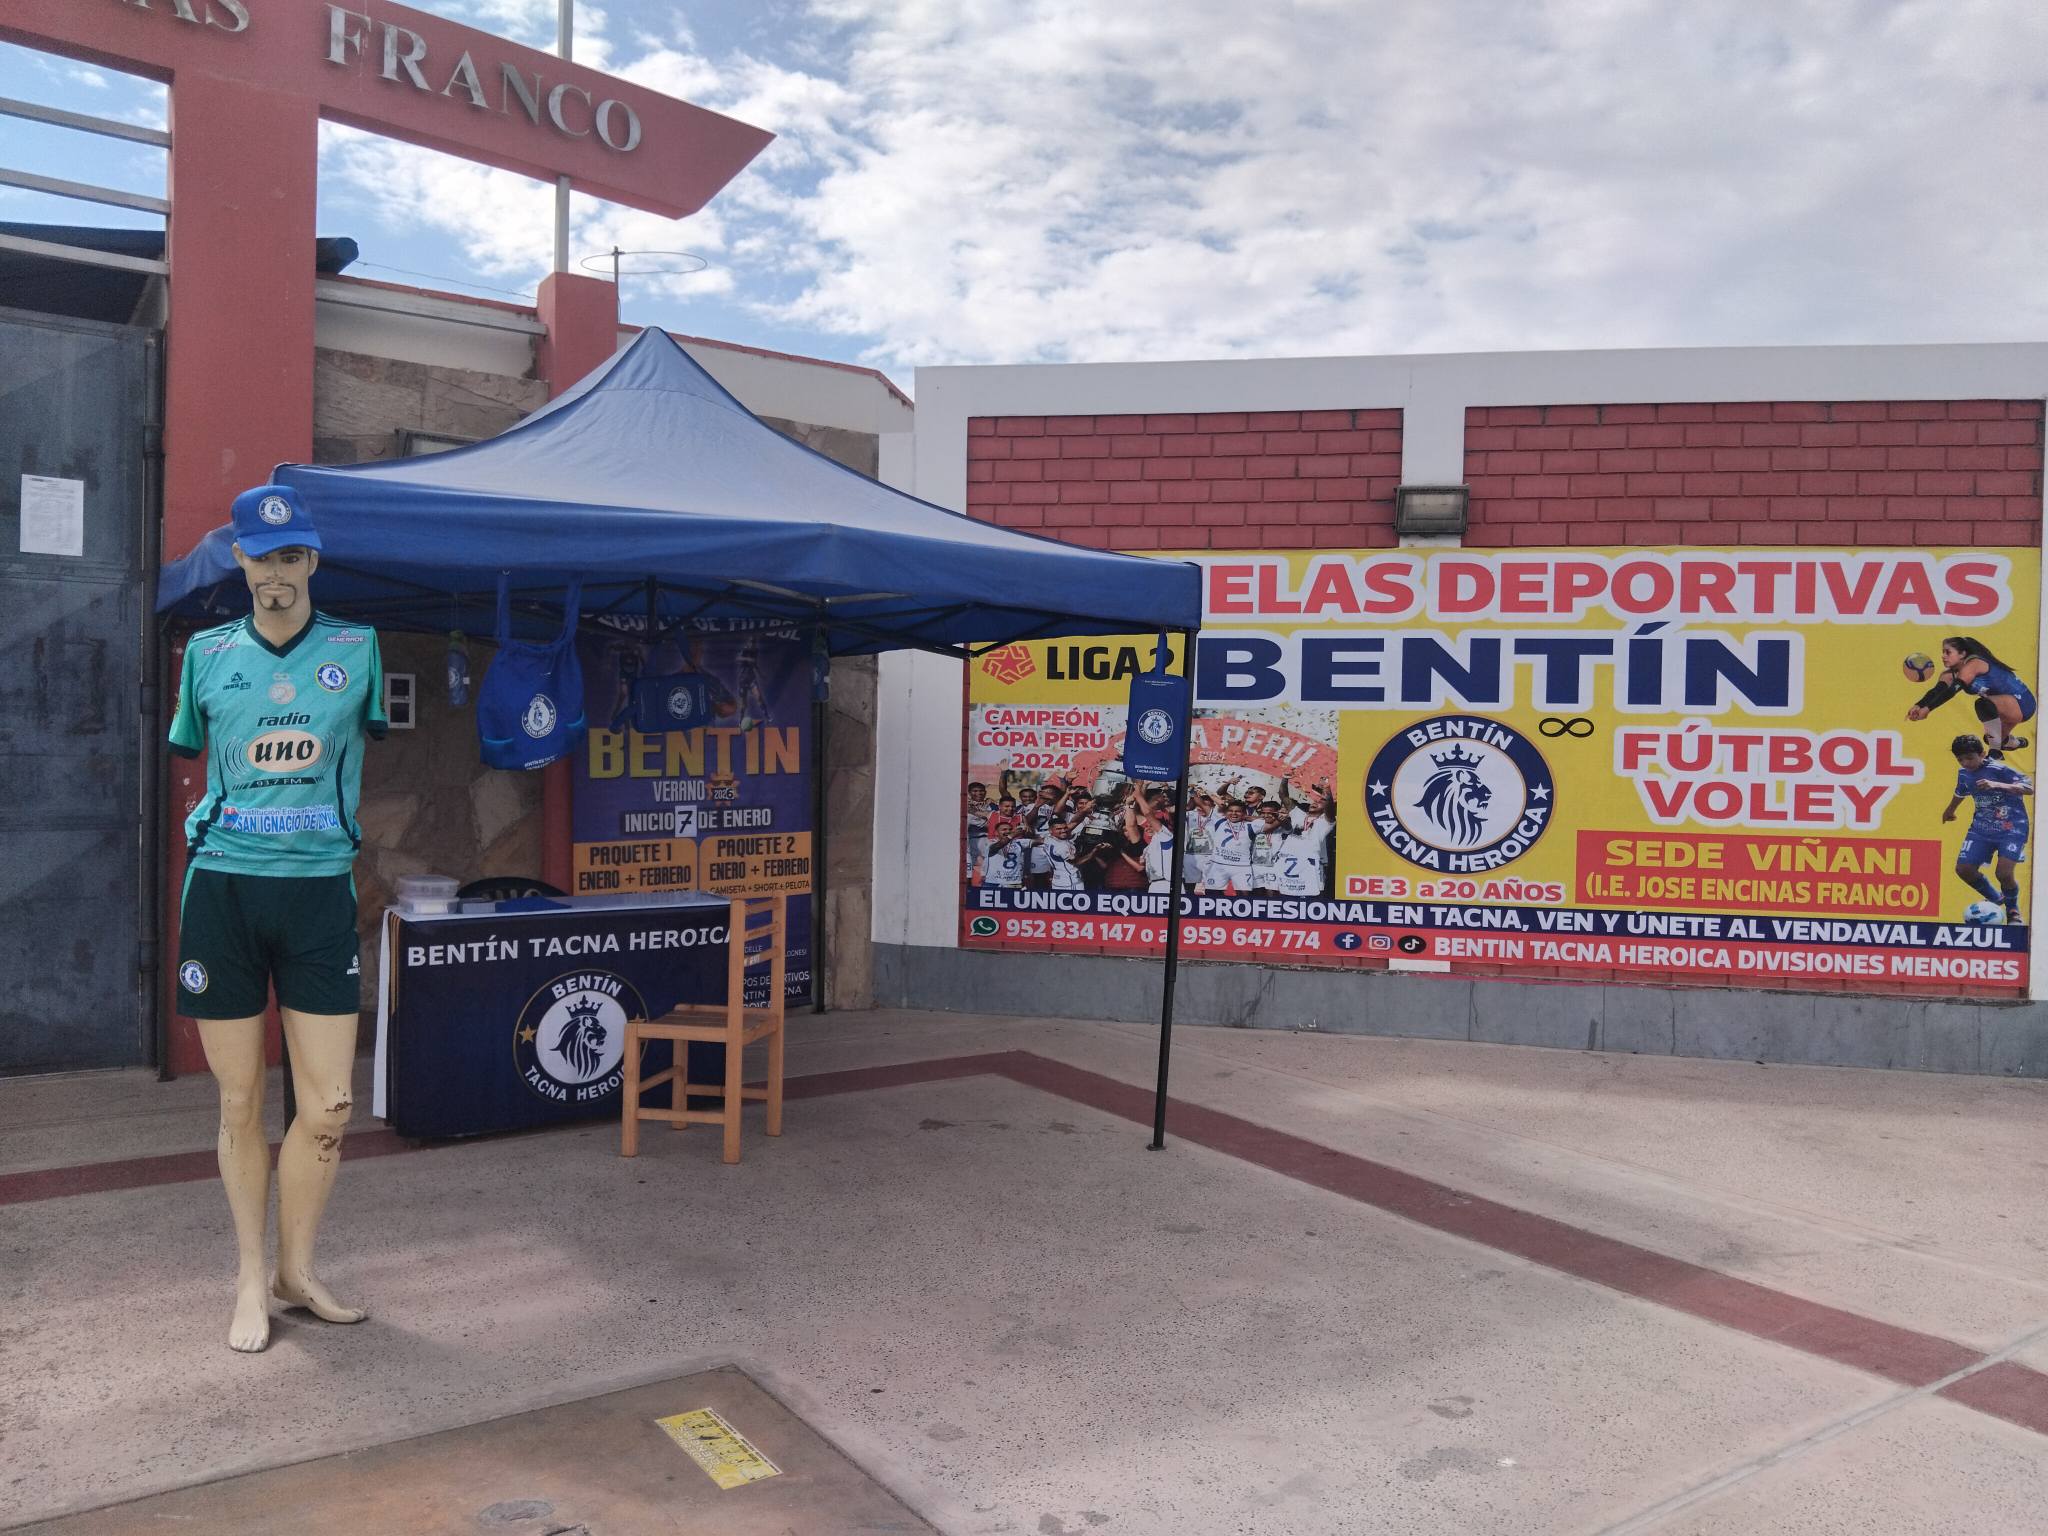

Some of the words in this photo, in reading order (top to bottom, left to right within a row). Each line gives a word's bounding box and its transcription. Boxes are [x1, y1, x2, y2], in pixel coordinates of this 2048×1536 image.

[321, 4, 643, 152] FRANCO
[1205, 562, 1416, 615] ELAS
[1438, 561, 2000, 617] DEPORTIVAS
[1047, 646, 1143, 681] LIGA
[1150, 646, 1176, 676] 2
[1196, 621, 1790, 707] BENTÍN
[257, 712, 311, 727] radio
[984, 707, 1100, 728] CAMPEÓN
[977, 731, 1042, 747] COPA
[1045, 728, 1106, 749] PERÚ
[1219, 724, 1318, 769] PERÚ
[1406, 719, 1514, 751] BENTÍN
[255, 739, 315, 764] uno
[1011, 752, 1071, 770] 2024
[1622, 724, 1915, 777] FÚTBOL
[653, 780, 706, 803] VERANO
[1643, 780, 1890, 823] VOLEY
[237, 815, 258, 832] SAN
[260, 813, 300, 833] IGNACIO
[303, 813, 317, 830] DE
[625, 812, 674, 833] INICIO
[678, 811, 693, 834] 7
[698, 811, 717, 829] DE
[723, 808, 772, 829] ENERO
[717, 837, 782, 857] PAQUETE
[787, 836, 796, 854] 2
[1373, 804, 1440, 870] TACNA
[1449, 807, 1548, 872] HEROICA
[590, 844, 660, 866] PAQUETE
[666, 843, 672, 861] 1
[1605, 839, 1725, 870] SEDE
[1745, 837, 1912, 876] VIÑANI
[579, 872, 620, 891] ENERO
[640, 866, 691, 887] FEBRERO
[710, 862, 746, 882] ENERO
[764, 858, 810, 878] FEBRERO
[753, 883, 778, 892] SHORT
[785, 880, 811, 891] PELOTA
[1349, 878, 1384, 895] DE
[1390, 879, 1407, 896] 3
[1419, 884, 1435, 897] a
[1440, 881, 1476, 899] 20
[1481, 879, 1562, 902] AÑOS
[1585, 872, 1631, 899] (I.E.
[1636, 874, 1696, 901] JOSE
[1700, 877, 1811, 905] ENCINAS
[1816, 880, 1930, 911] FRANCO)
[979, 889, 1008, 909] EL
[1199, 896, 1382, 924] PROFESIONAL
[1387, 904, 1424, 925] EN
[1429, 906, 1530, 931] TACNA,
[1536, 911, 1597, 932] VEN
[1601, 913, 1623, 934] Y
[1626, 910, 1721, 938] ÚNETE
[1727, 919, 1765, 939] AL
[1772, 921, 1929, 946] VENDAVAL
[1932, 926, 2011, 949] AZUL
[1006, 919, 1047, 938] 952
[1051, 921, 1094, 940] 834
[1099, 922, 1135, 942] 147
[1140, 928, 1154, 943] o
[1183, 926, 1228, 946] 959
[1232, 928, 1276, 948] 647
[1280, 929, 1321, 950] 774
[407, 935, 519, 967] BENTÍN
[529, 933, 620, 958] TACNA
[1434, 936, 1523, 960] BENTIN
[1529, 940, 1615, 965] TACNA
[1618, 944, 1732, 969] HEROICA
[1738, 948, 1885, 976] DIVISIONES
[1891, 954, 2020, 981] MENORES
[552, 974, 622, 1000] BENTÍN
[743, 990, 766, 1000] NTIN
[524, 1065, 568, 1101] TACNA
